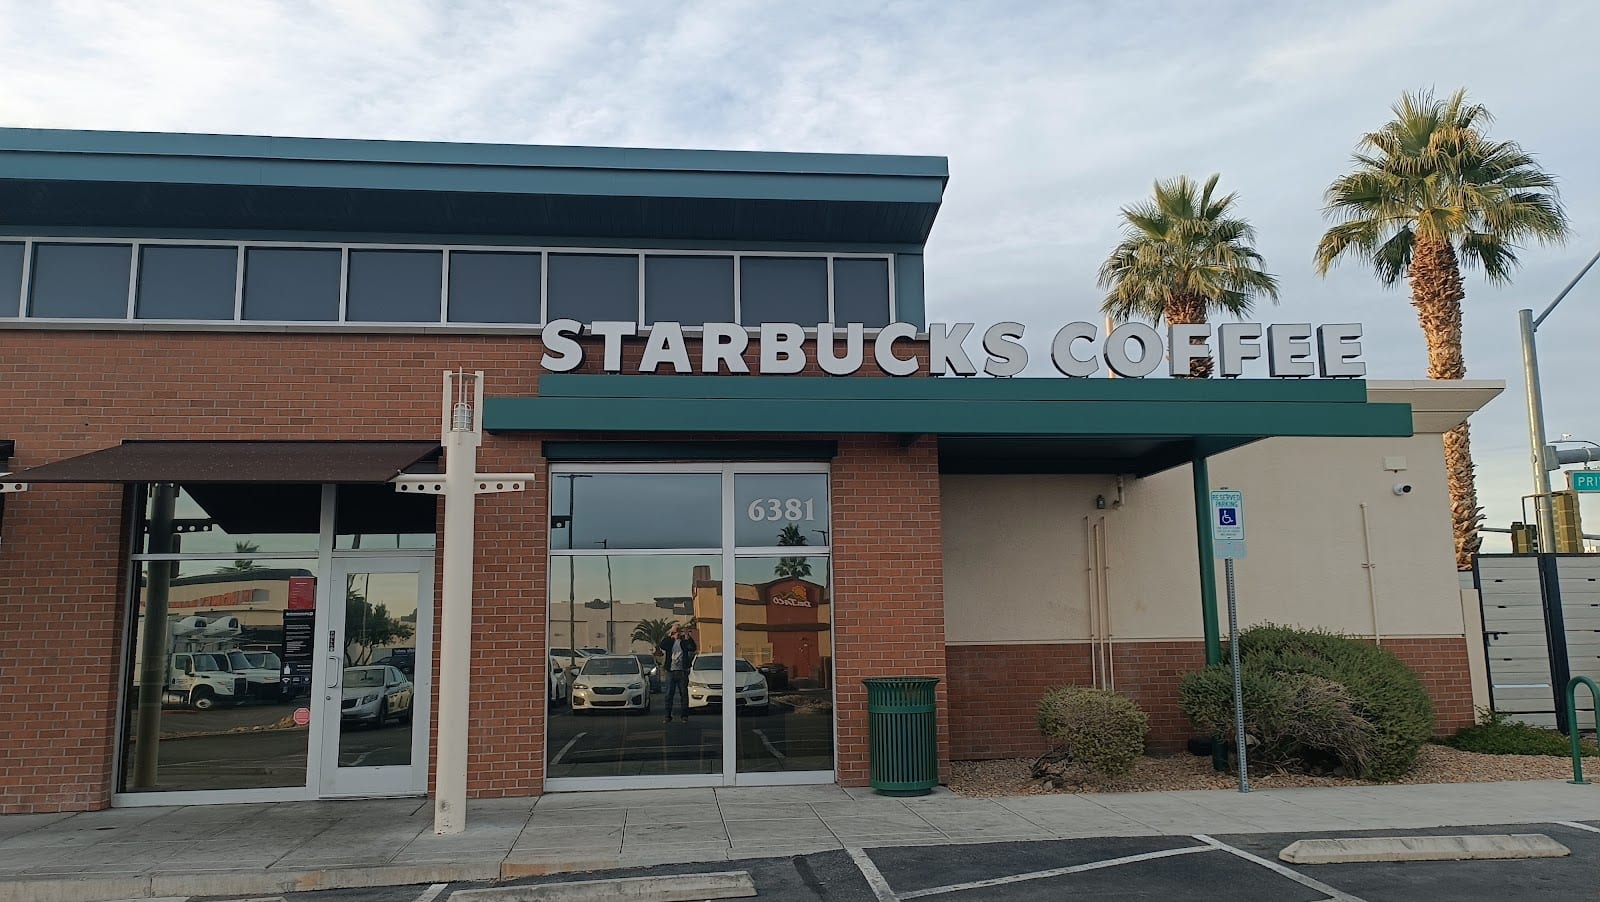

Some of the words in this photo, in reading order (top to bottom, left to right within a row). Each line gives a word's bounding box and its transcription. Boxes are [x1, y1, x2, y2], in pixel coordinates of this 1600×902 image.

[541, 318, 1029, 377] STARBUCKS
[1050, 321, 1367, 378] COFFEE
[1578, 476, 1600, 487] PRI
[748, 498, 815, 521] 6381
